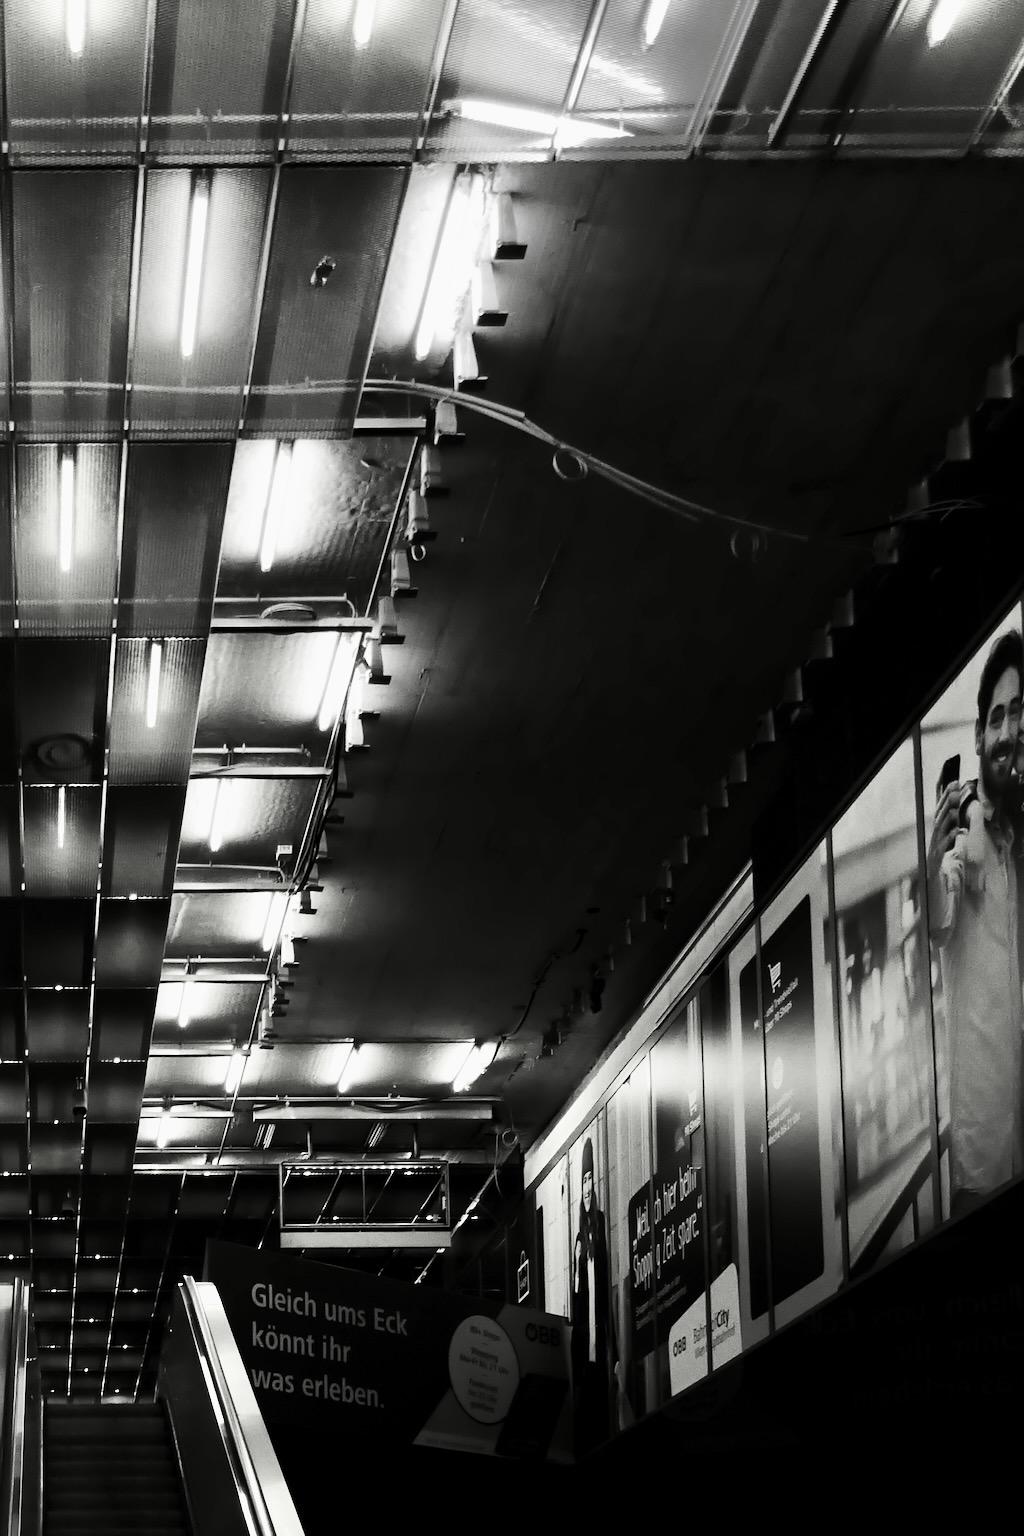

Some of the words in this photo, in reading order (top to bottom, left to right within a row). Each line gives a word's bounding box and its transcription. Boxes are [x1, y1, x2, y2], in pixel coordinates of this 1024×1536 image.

[632, 1243, 662, 1292] Shoppig
[661, 1224, 677, 1264] Zeit
[250, 1282, 317, 1318] Gleich
[323, 1302, 367, 1328] ums
[373, 1307, 408, 1337] Eck
[251, 1320, 315, 1358] könnt
[322, 1334, 352, 1363] ihr
[250, 1367, 295, 1394] was
[301, 1373, 386, 1409] erleben.
